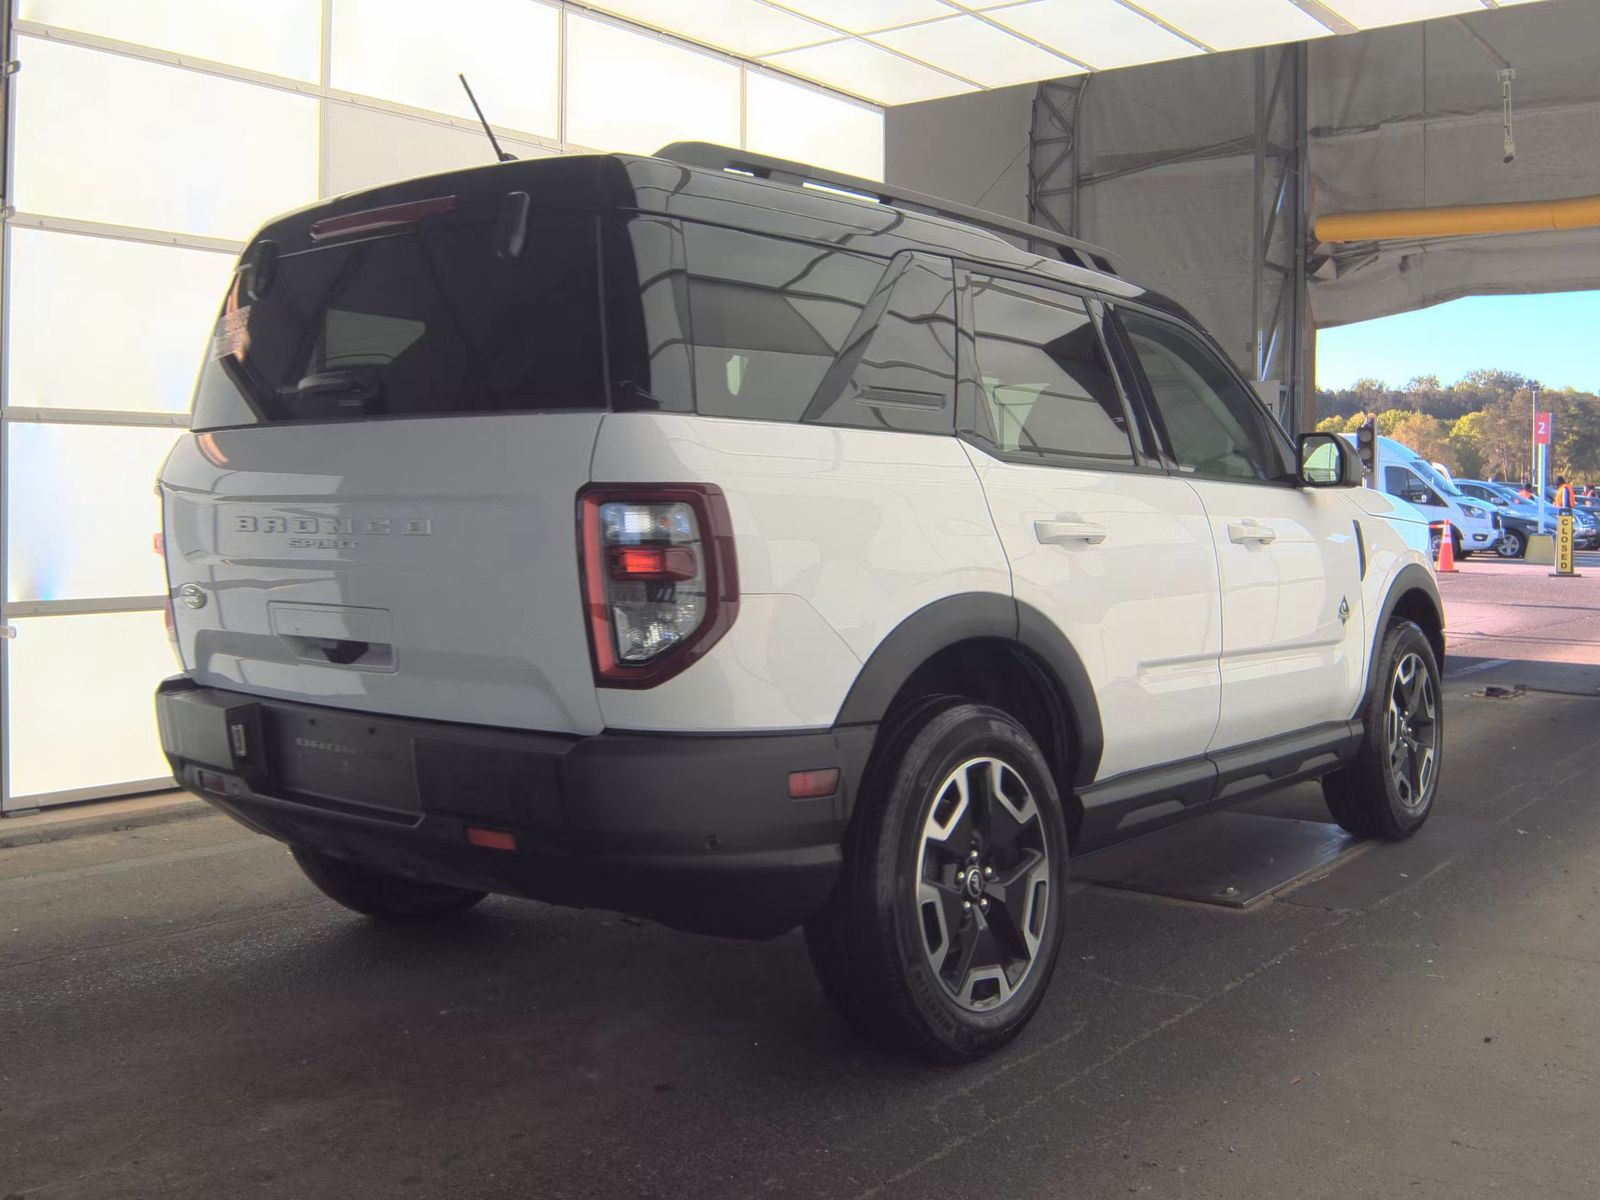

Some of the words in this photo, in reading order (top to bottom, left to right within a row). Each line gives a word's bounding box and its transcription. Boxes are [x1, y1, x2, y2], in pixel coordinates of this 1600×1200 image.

[1537, 421, 1546, 435] 2
[234, 515, 432, 537] BRONCO
[287, 537, 360, 549] SPORT
[1560, 518, 1569, 570] CLOSED
